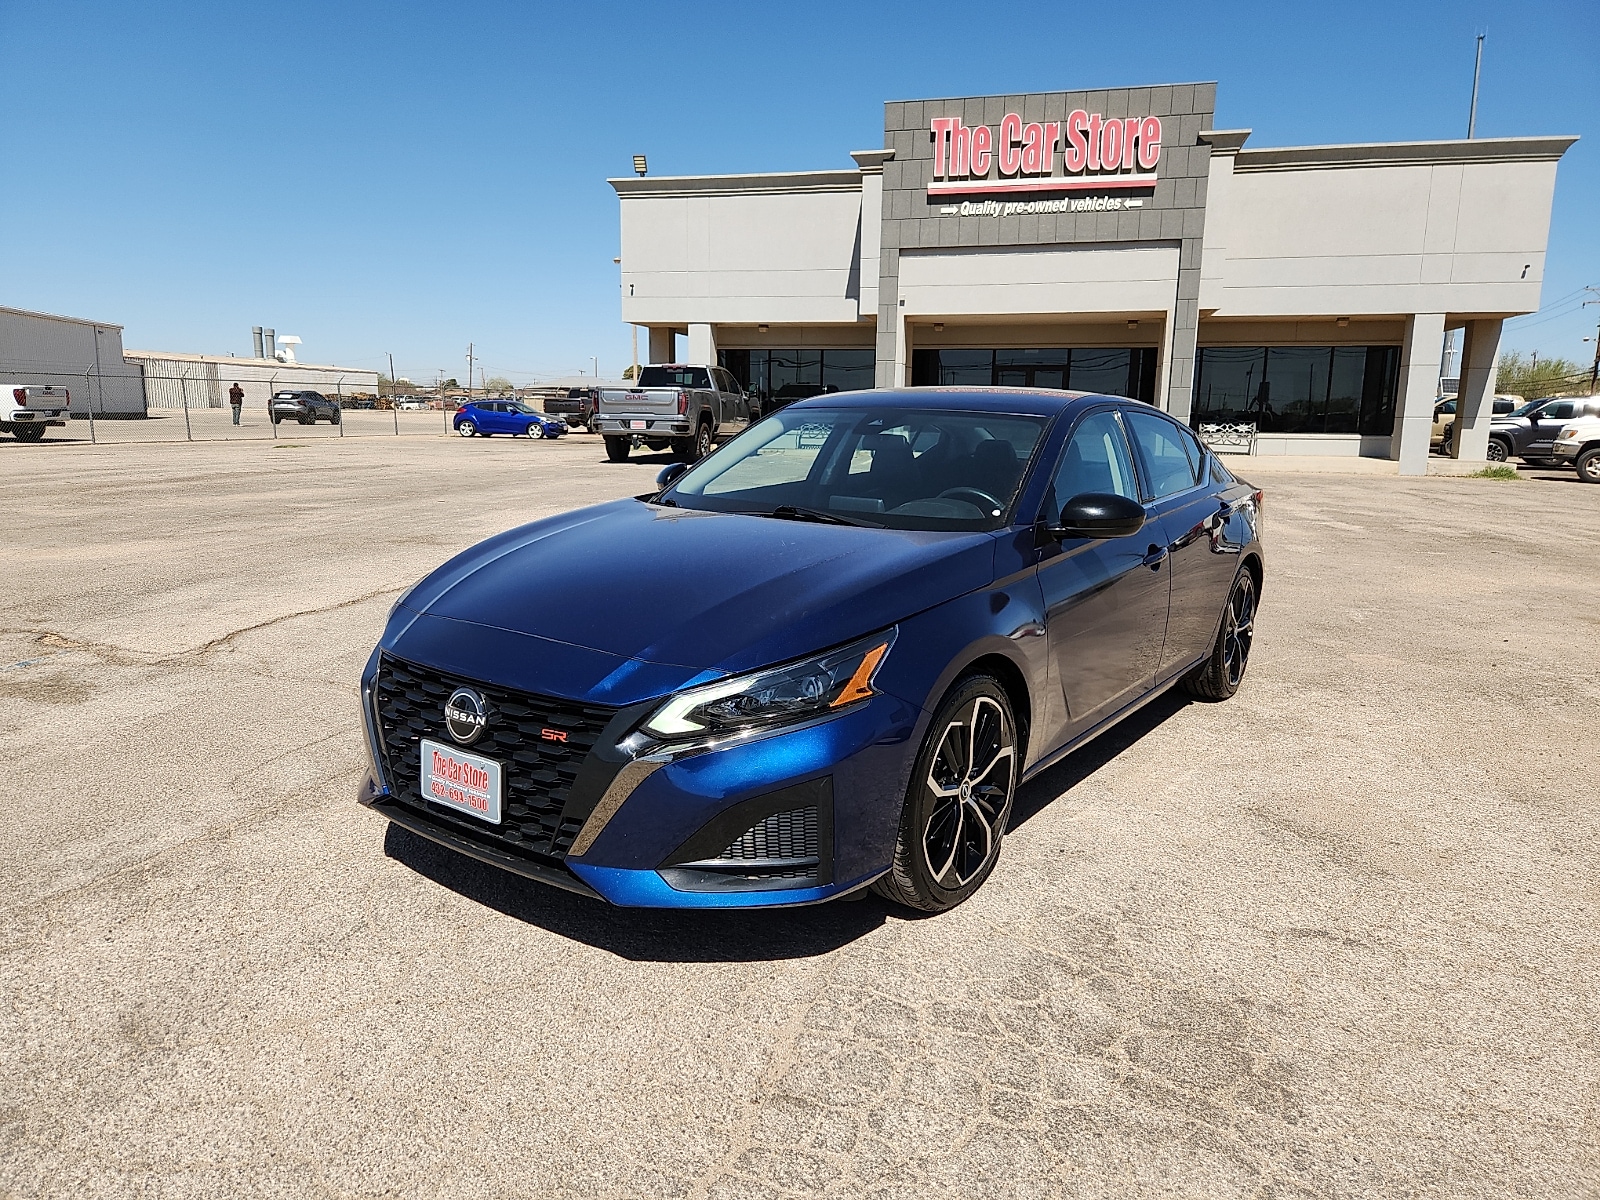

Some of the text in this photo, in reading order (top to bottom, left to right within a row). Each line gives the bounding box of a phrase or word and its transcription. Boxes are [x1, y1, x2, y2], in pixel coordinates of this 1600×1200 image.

[931, 109, 1162, 178] The Car Store
[960, 196, 1122, 217] Quality pre-owned vehicles
[445, 705, 485, 726] NISSAN
[541, 727, 568, 742] SR
[432, 750, 447, 777] The
[448, 757, 462, 782] Car
[463, 762, 489, 791] Store
[431, 780, 489, 812] 432-694-1500
